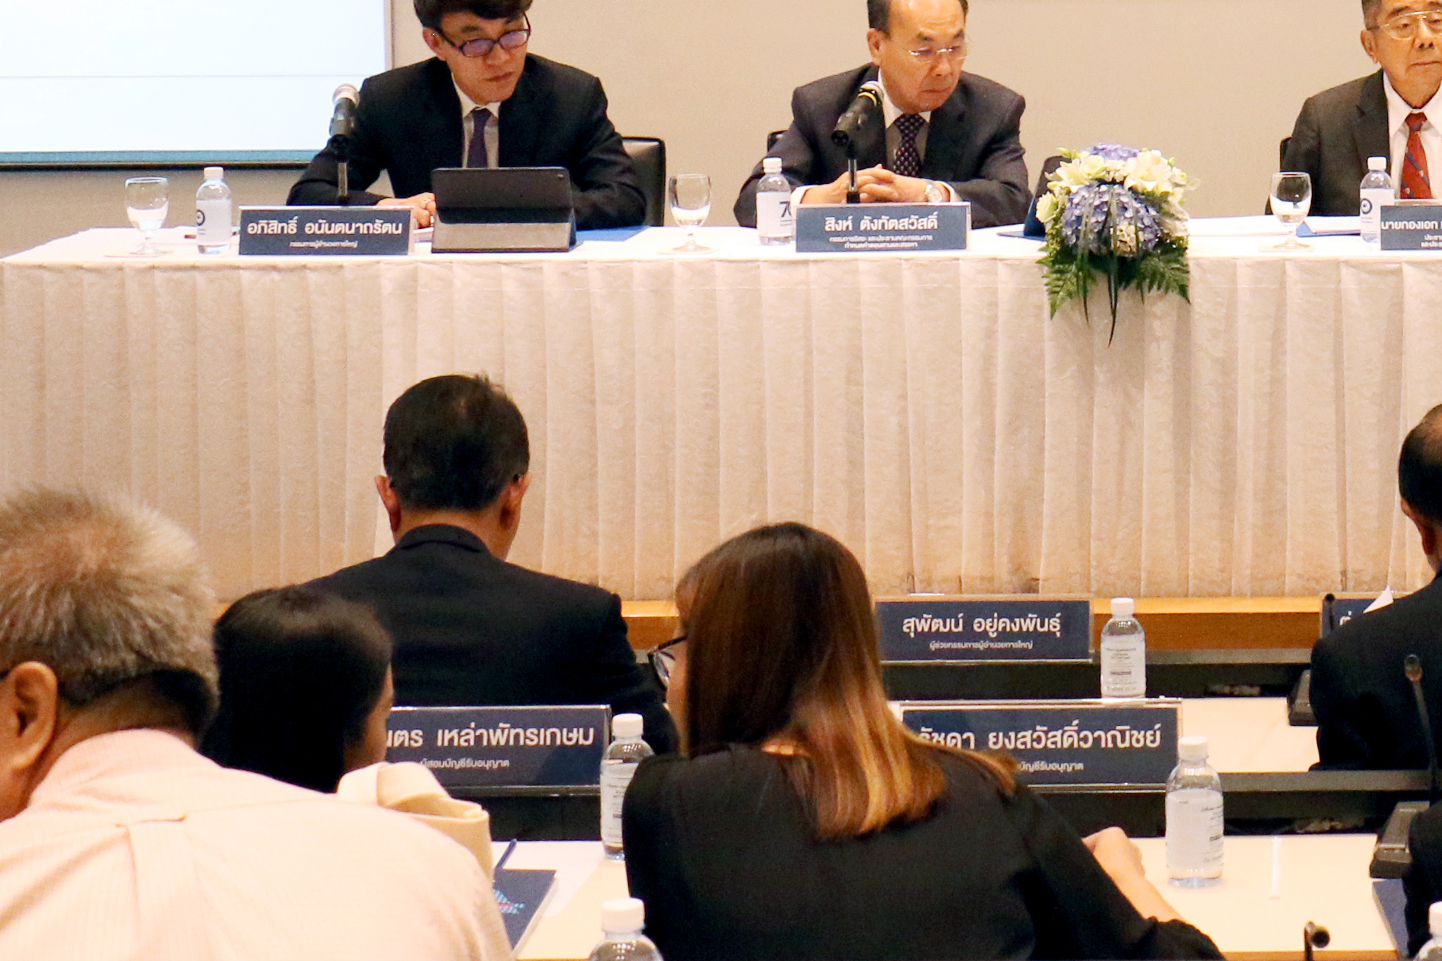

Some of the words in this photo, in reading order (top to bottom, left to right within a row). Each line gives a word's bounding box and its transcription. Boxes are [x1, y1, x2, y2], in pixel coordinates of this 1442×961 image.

[247, 215, 299, 235] อภิสิทธิ์
[304, 218, 403, 235] อนันตนาถรัตน
[824, 215, 854, 232] สิงห์
[859, 211, 939, 231] ตังทัตสวัสดิ์
[902, 612, 964, 638] สุพัฒน์
[972, 612, 1062, 638] อยู่คงพันธุ์
[987, 719, 1162, 750] ยงสวัสดิ์วาณิชย์
